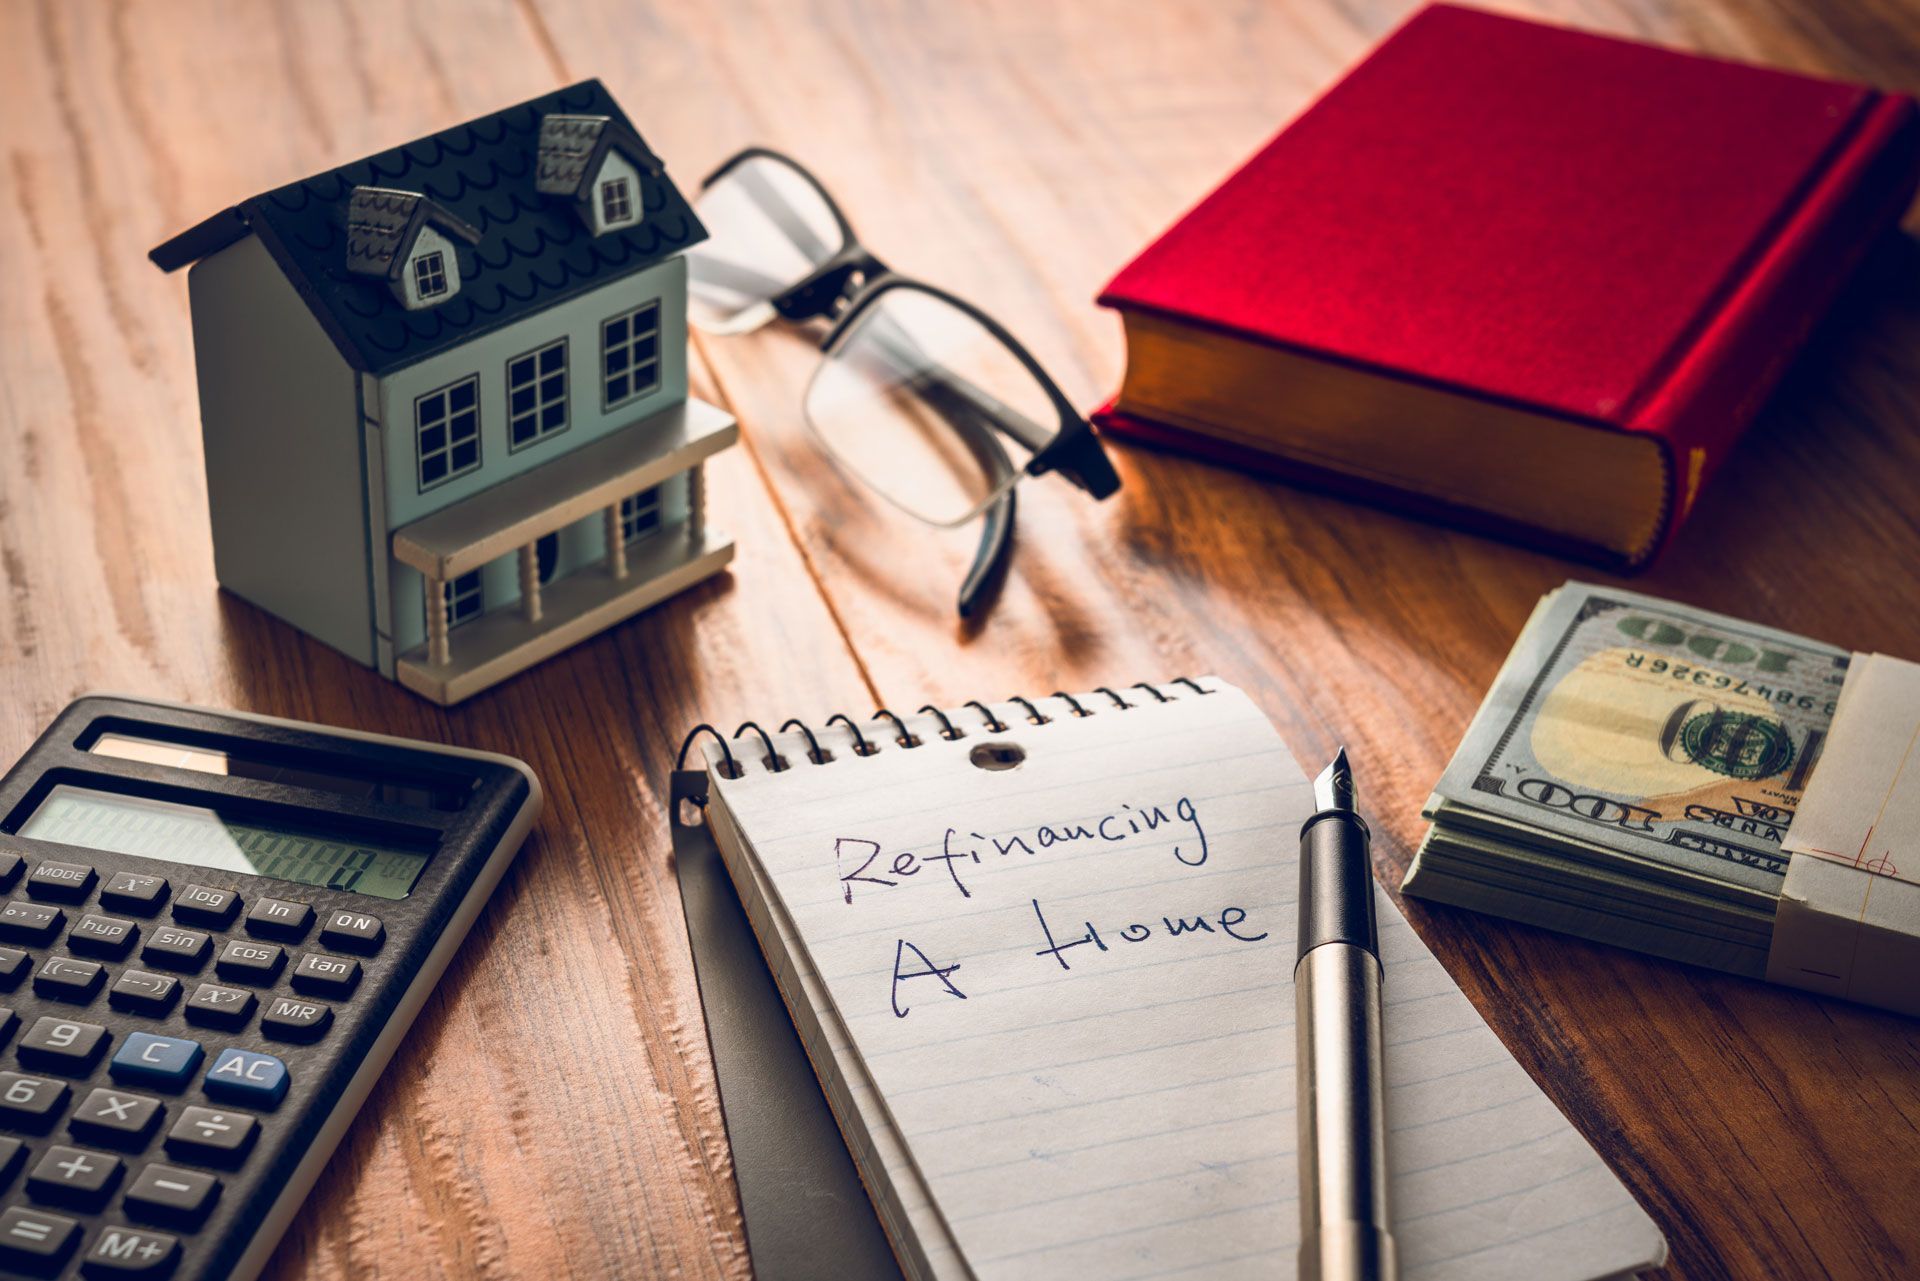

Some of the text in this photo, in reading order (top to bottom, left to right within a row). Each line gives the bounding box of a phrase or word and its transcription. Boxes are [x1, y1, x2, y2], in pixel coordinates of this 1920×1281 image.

[1517, 778, 1662, 832] 100
[833, 797, 1208, 904] Refinancing
[35, 866, 86, 881] MODE
[188, 885, 224, 907] log
[82, 919, 123, 936] hyp
[336, 914, 371, 930] ON
[159, 932, 195, 948] sin
[230, 946, 270, 961] cos
[892, 898, 1268, 1018] A Home
[308, 956, 347, 975] tan
[276, 1002, 317, 1020] MR
[46, 1024, 81, 1047] 9
[141, 1042, 171, 1063] C
[216, 1055, 275, 1081] AC
[5, 1079, 41, 1103] 6
[98, 1232, 163, 1260] M+
